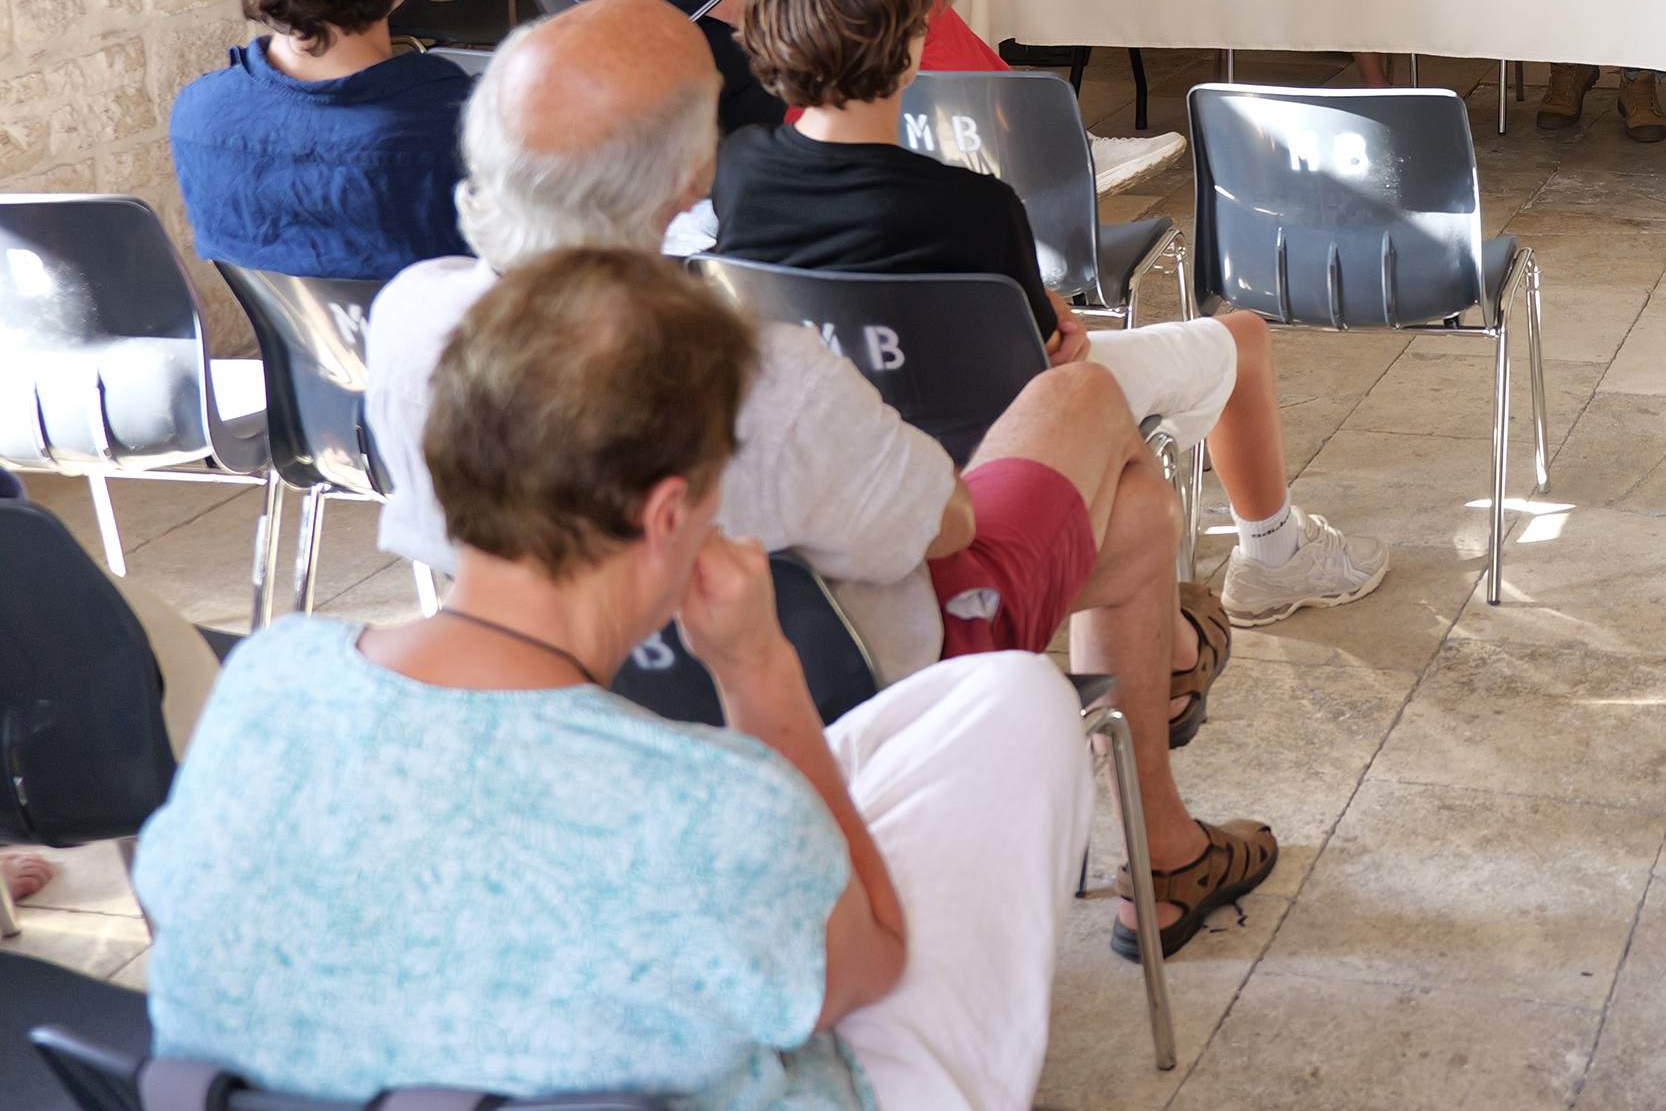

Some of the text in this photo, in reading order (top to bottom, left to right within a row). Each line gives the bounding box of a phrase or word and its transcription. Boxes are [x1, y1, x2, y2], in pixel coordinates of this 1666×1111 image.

[903, 113, 982, 152] M B
[1334, 132, 1369, 175] B
[864, 325, 906, 371] B
